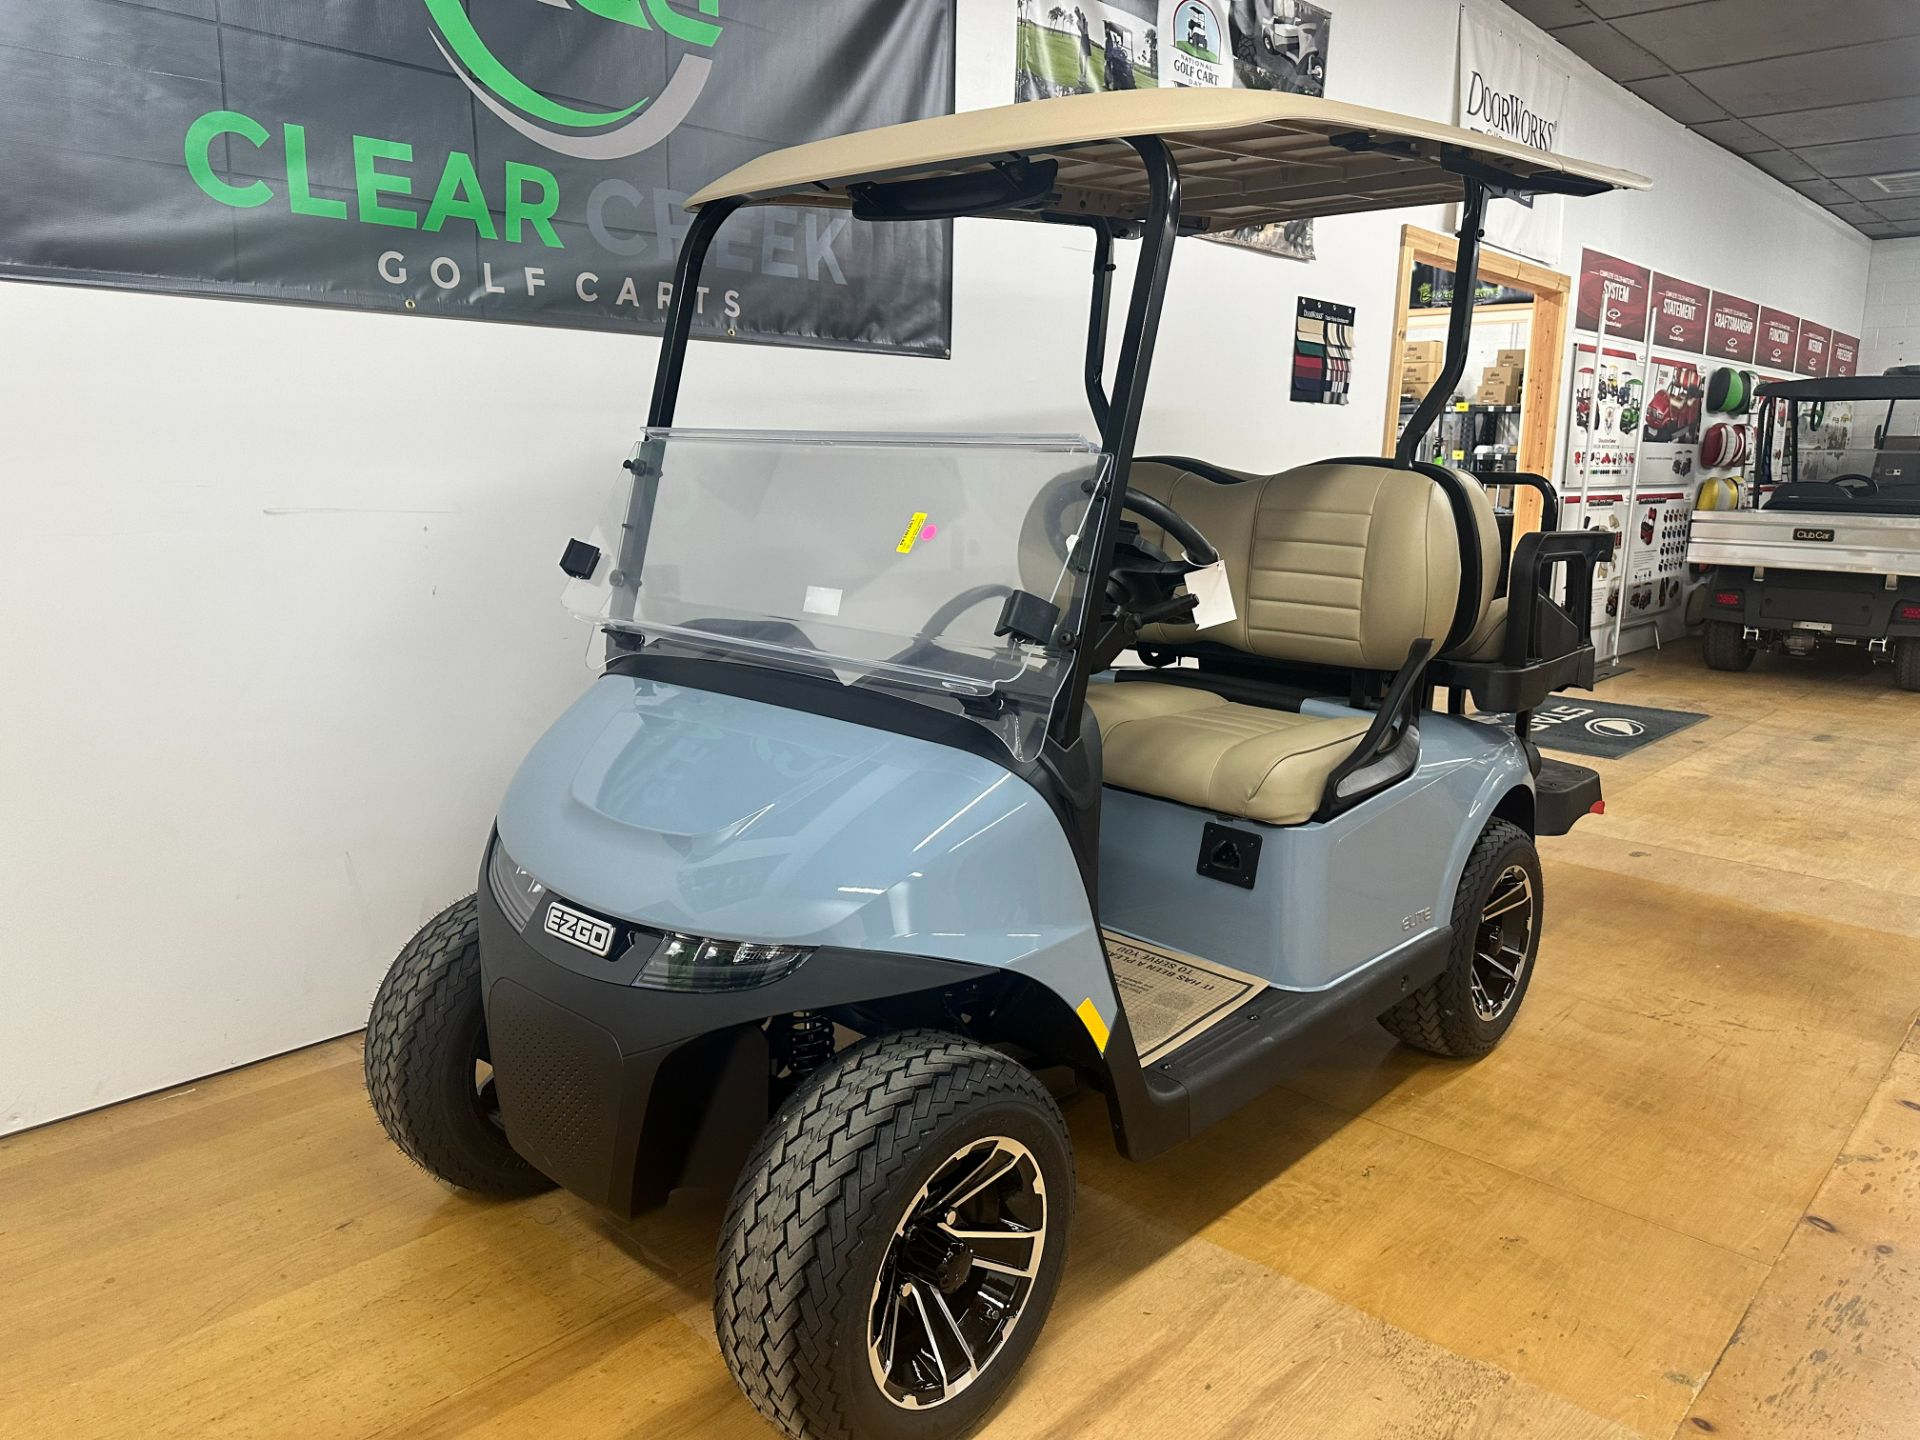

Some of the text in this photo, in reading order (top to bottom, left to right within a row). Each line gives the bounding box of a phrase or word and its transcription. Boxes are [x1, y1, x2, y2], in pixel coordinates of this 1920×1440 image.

[1173, 59, 1219, 86] GOLF CART
[1181, 54, 1213, 71] NATIONAL
[1188, 78, 1203, 87] DAY
[184, 110, 565, 249] CLEAR
[377, 250, 545, 297] GOLF
[1603, 280, 1630, 303] SYSTEM
[1663, 299, 1696, 320] STATEMENT
[1714, 312, 1753, 335] CRAFTSMANSHIP
[1402, 906, 1432, 931] ELITE
[1107, 950, 1137, 964] PLEA
[1116, 946, 1194, 975] TO SERVE YOU
[1146, 964, 1176, 977] BEEN
[1176, 975, 1201, 987] HAS
